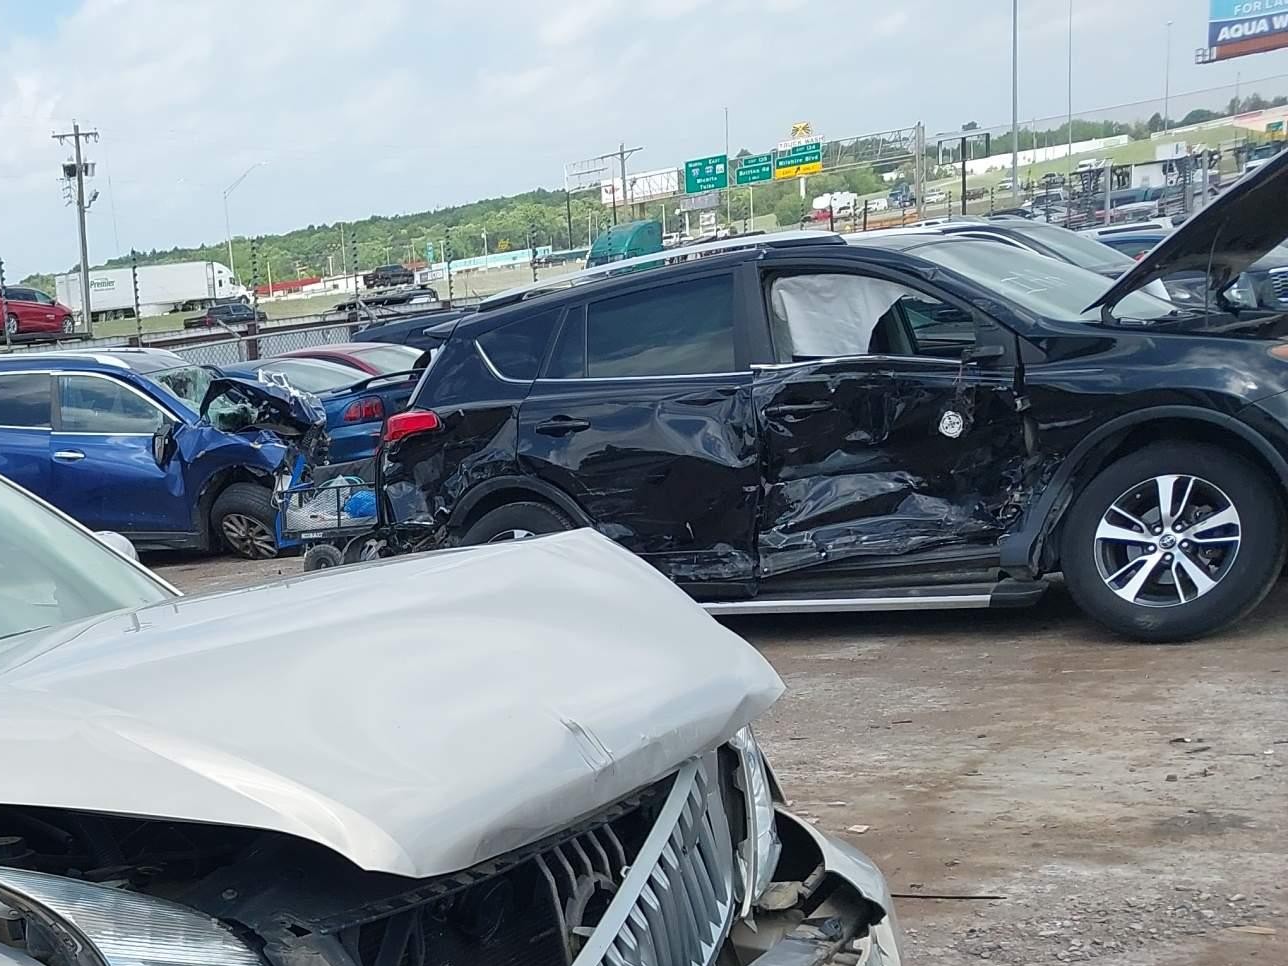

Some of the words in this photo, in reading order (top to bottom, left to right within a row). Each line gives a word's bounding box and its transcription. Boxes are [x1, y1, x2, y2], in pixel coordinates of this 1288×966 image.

[1234, 0, 1262, 16] FOR
[1217, 18, 1269, 41] AQUA
[804, 154, 819, 163] Blvd
[761, 165, 770, 173] Rd
[90, 279, 115, 289] Premier
